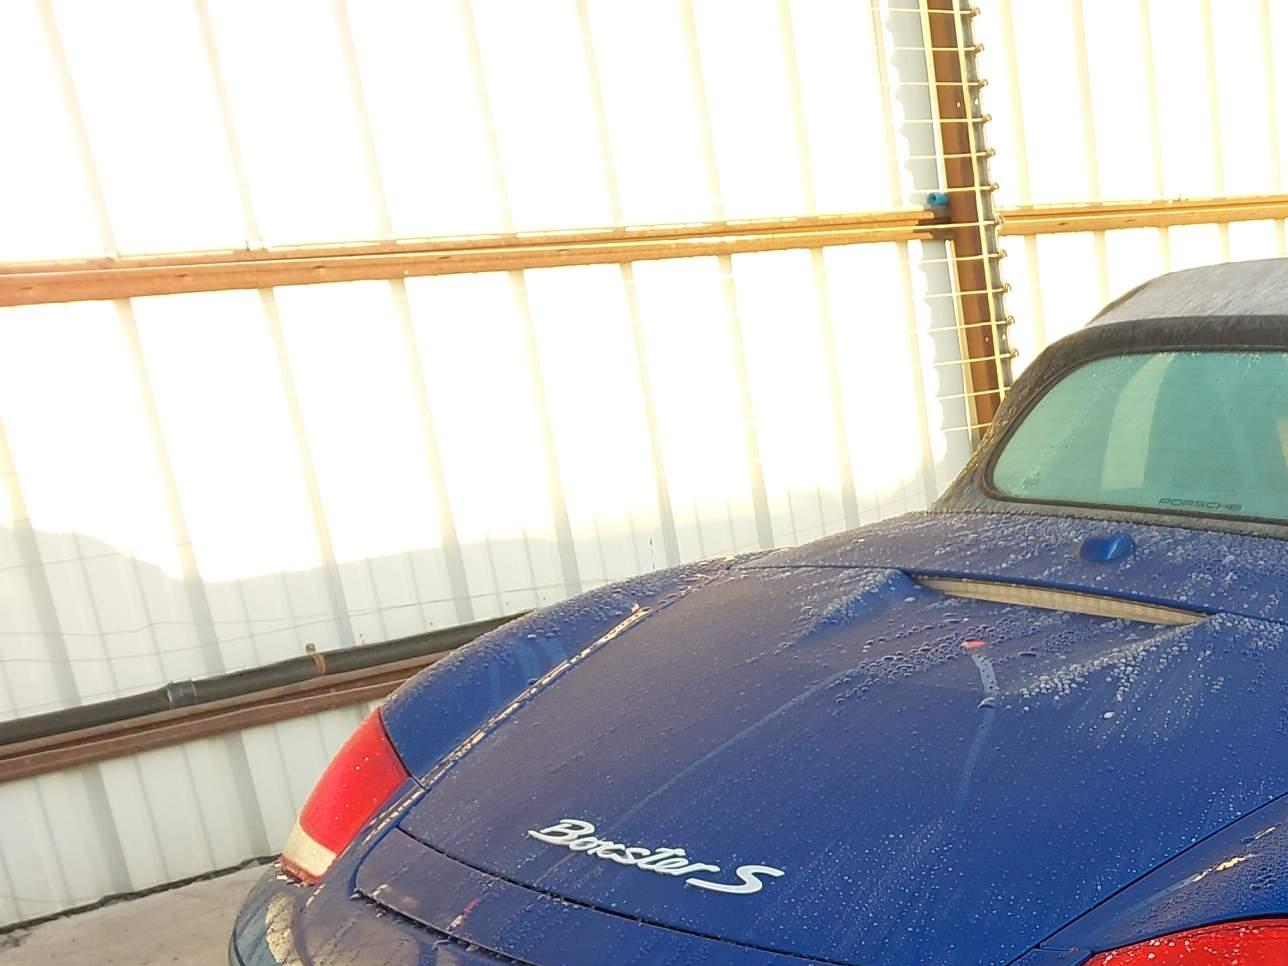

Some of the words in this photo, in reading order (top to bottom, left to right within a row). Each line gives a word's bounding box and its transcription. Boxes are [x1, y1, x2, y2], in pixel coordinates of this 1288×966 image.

[1158, 497, 1242, 512] PORSCHE
[528, 819, 721, 876] Boxster
[686, 865, 786, 894] S
